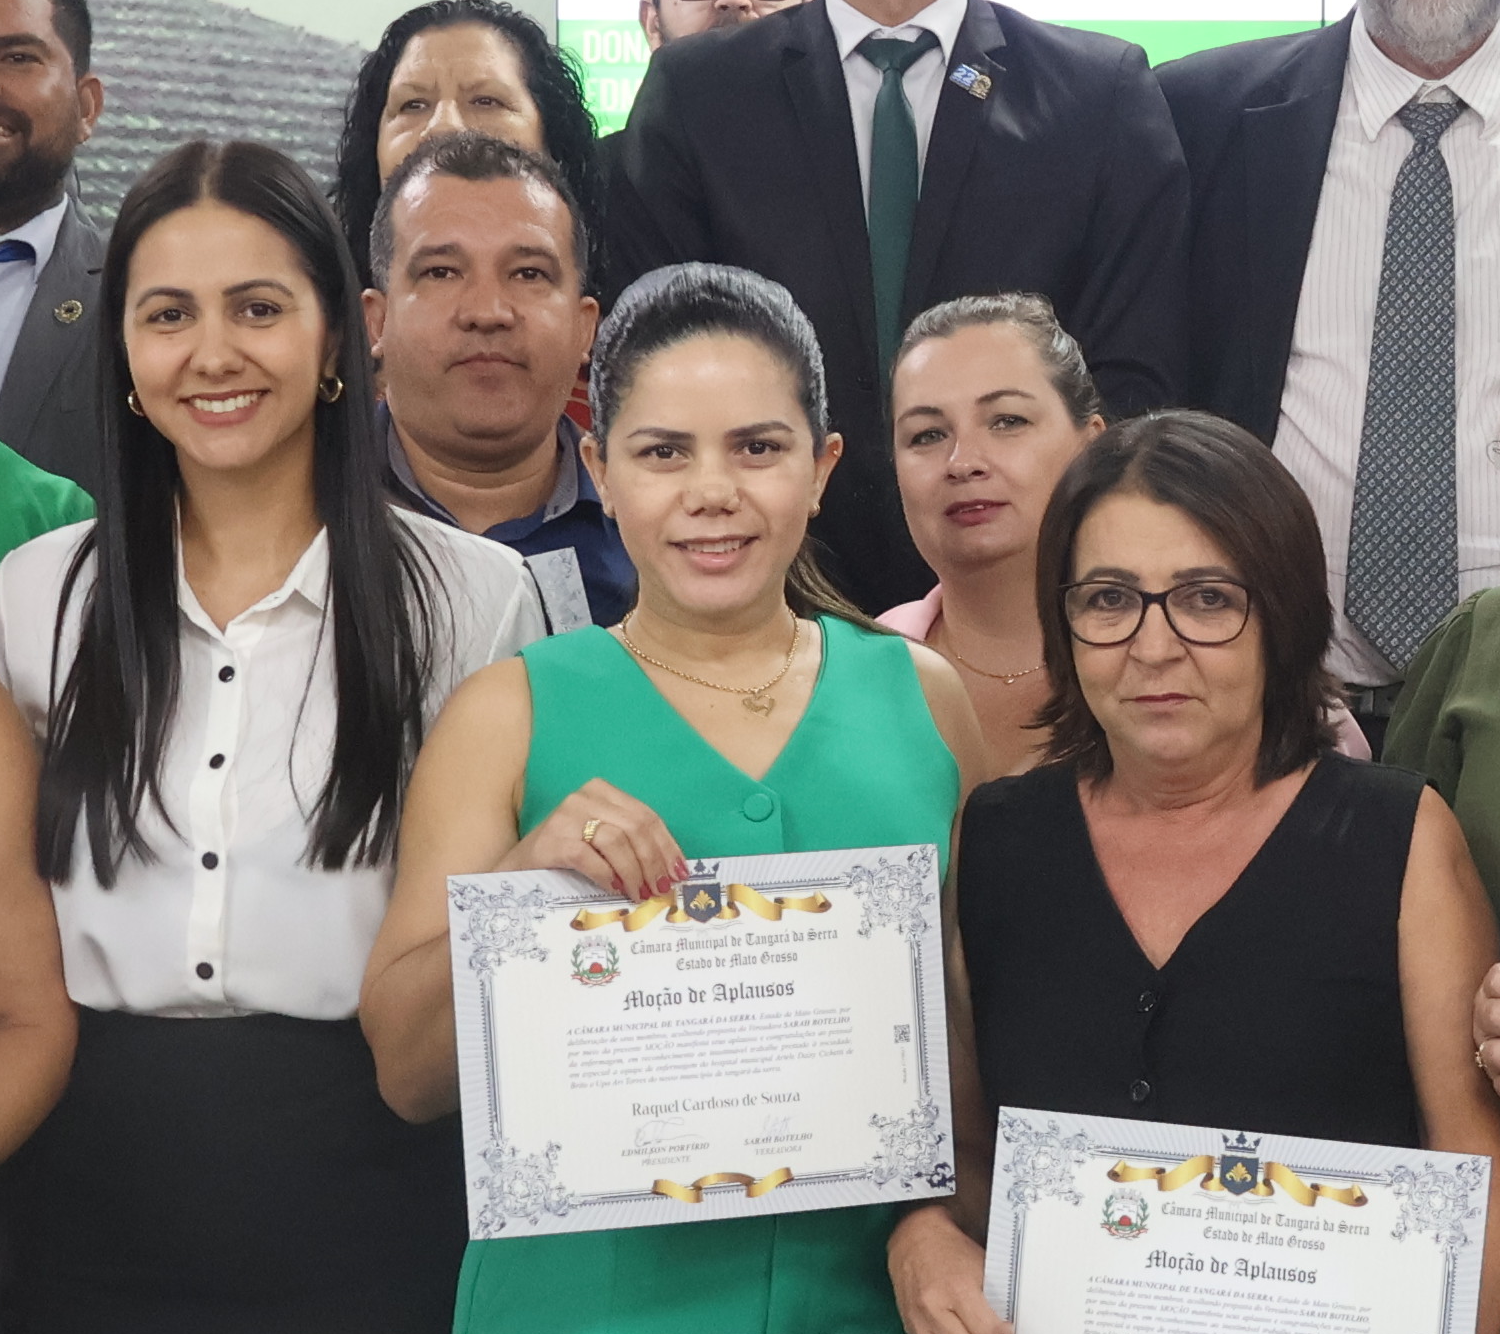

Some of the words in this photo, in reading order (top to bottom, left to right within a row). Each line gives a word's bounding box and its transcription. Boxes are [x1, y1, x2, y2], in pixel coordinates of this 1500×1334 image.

[623, 987, 682, 1011] Moção
[688, 987, 706, 1003] de
[712, 981, 794, 1003] Aplausos
[632, 1100, 679, 1118] Raquel
[682, 1096, 739, 1112] Cardoso
[742, 1094, 757, 1106] de
[761, 1092, 800, 1104] Souza
[1161, 1201, 1202, 1218] Câmara
[1204, 1206, 1257, 1225] Municipal
[1261, 1213, 1271, 1225] de
[1275, 1213, 1320, 1231] Tangará
[1323, 1219, 1334, 1232] da
[1338, 1220, 1369, 1235] Serra
[1203, 1226, 1238, 1242] Estado
[1242, 1230, 1253, 1243] de
[1256, 1231, 1284, 1246] Mato
[1287, 1235, 1325, 1251] Grosso
[1145, 1250, 1204, 1274] Moção
[1210, 1257, 1228, 1275] de
[1234, 1258, 1317, 1284] Aplausos
